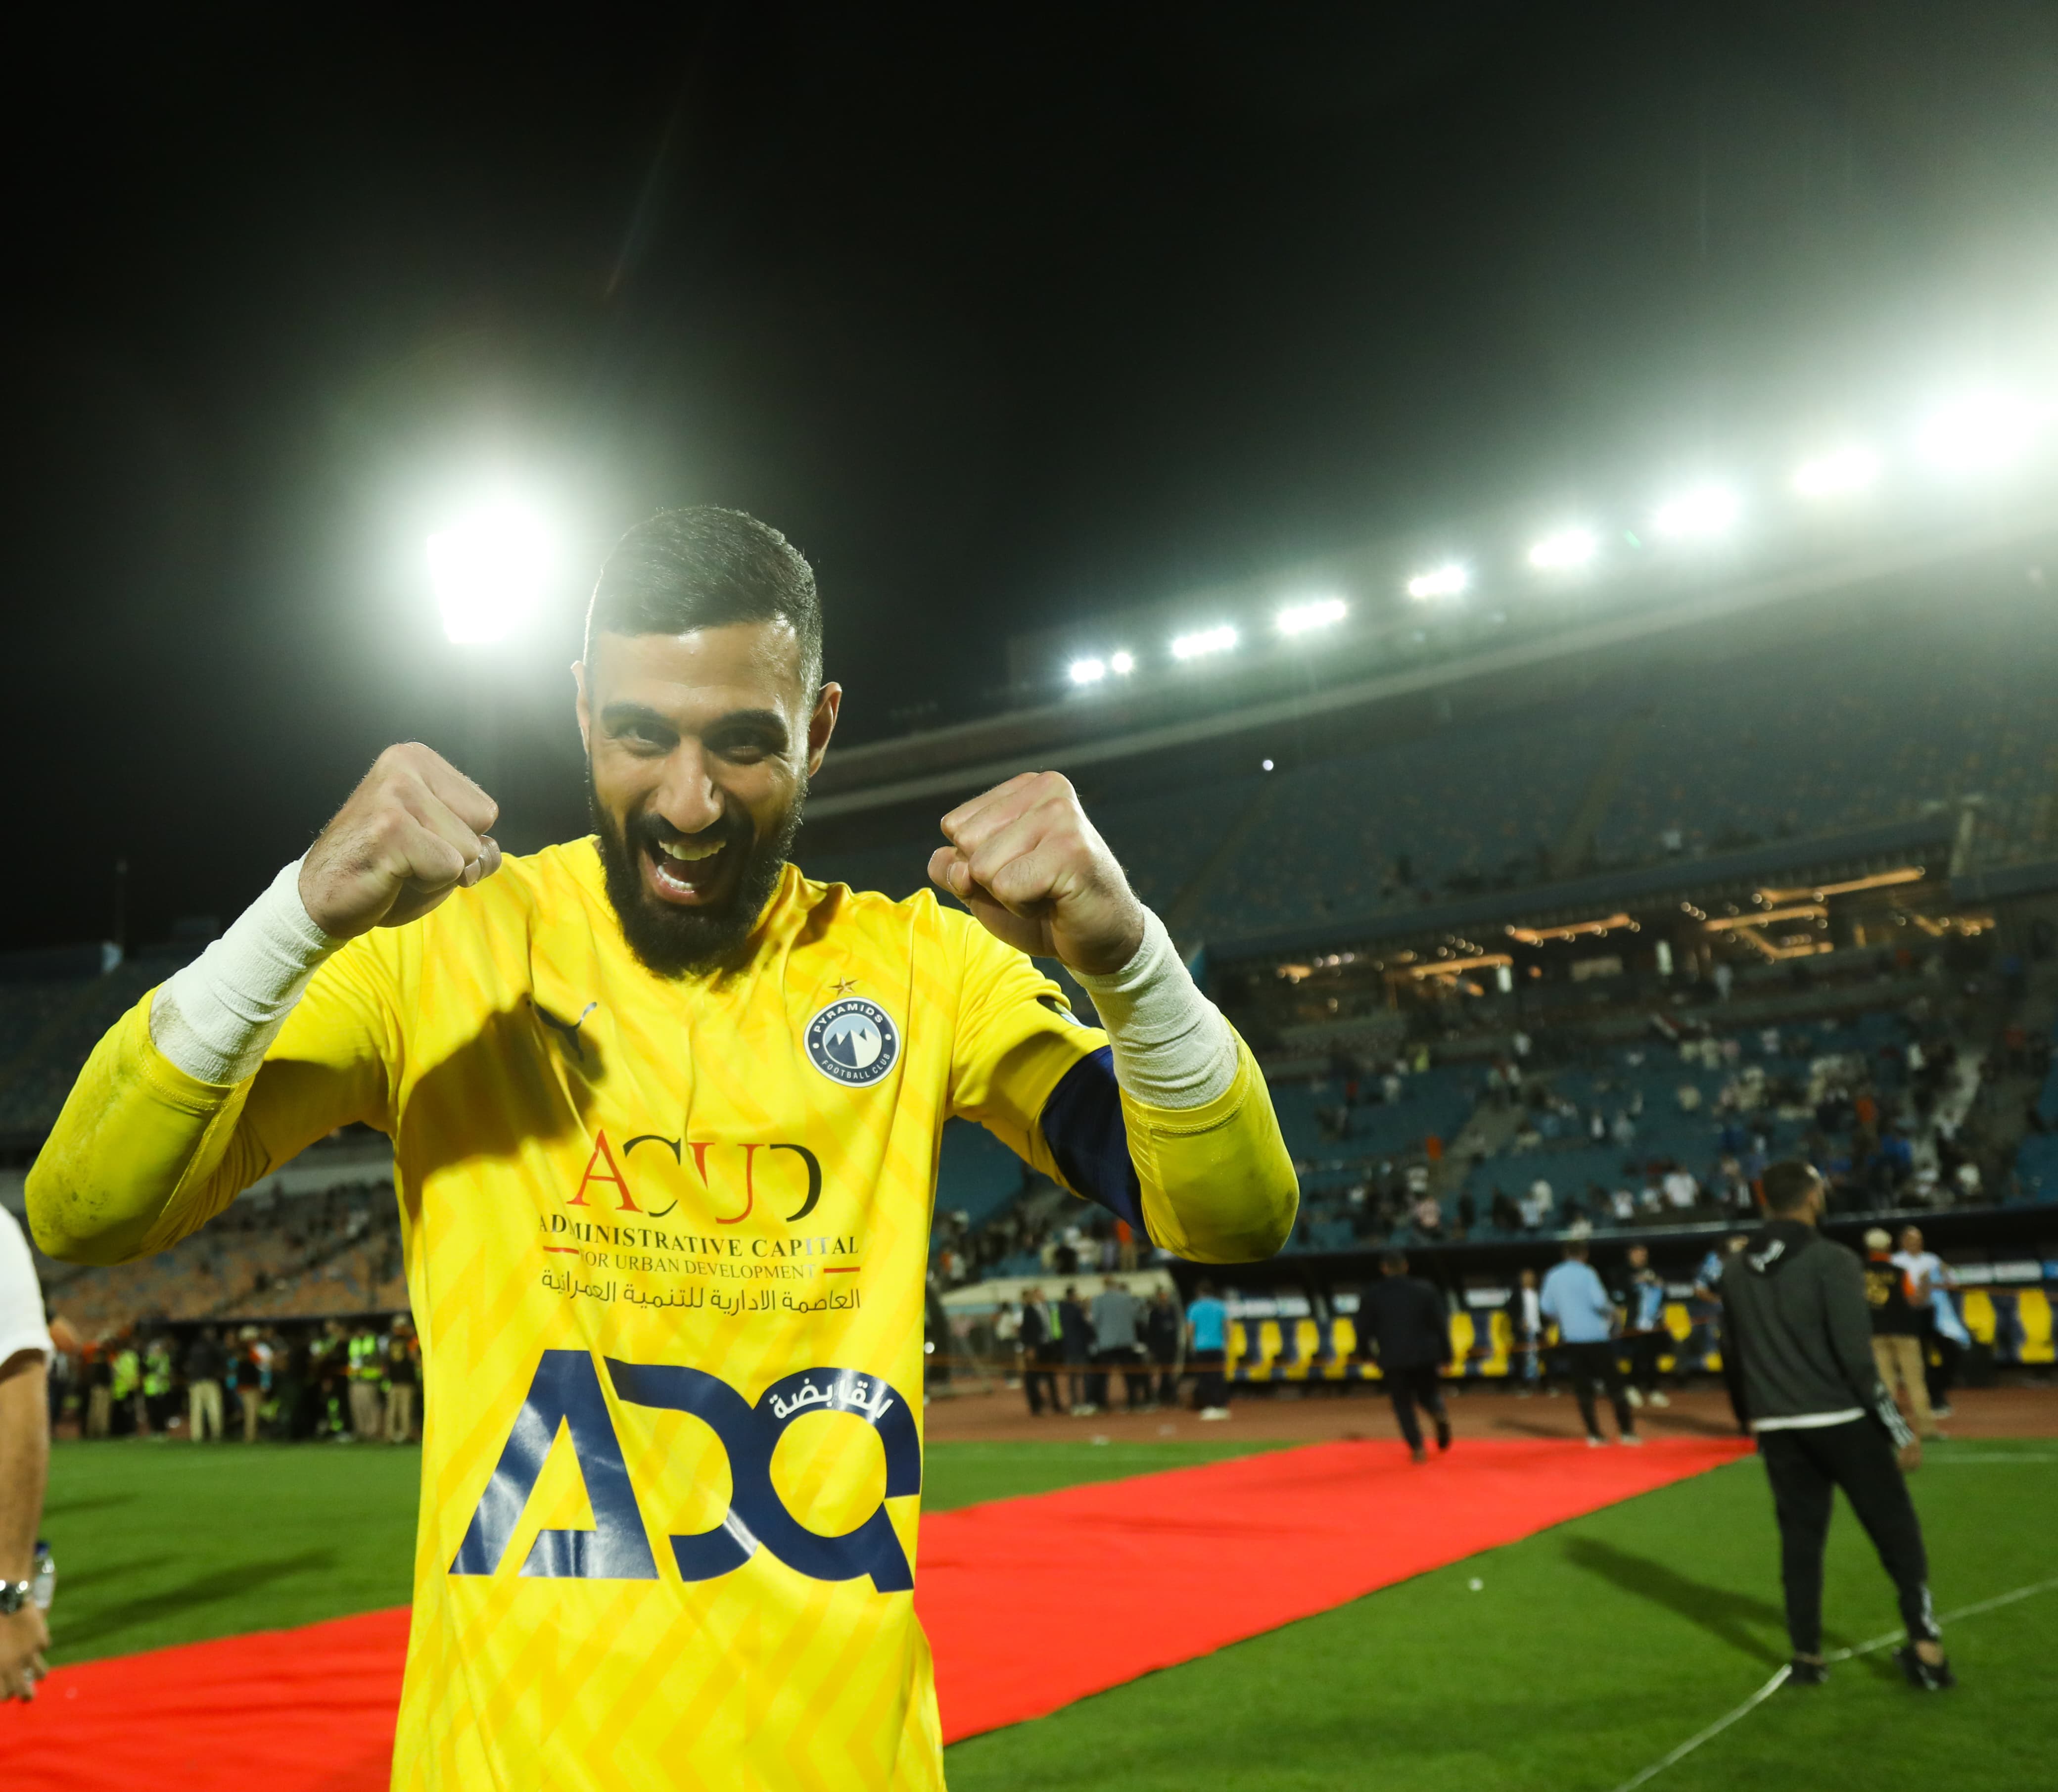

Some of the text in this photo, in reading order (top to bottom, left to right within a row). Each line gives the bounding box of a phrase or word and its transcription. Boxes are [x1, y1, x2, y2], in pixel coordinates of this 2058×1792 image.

[814, 1003, 883, 1033] PYRAMIDS
[822, 1054, 890, 1079] FOOTBALL CLUB
[566, 1129, 822, 1224] ACUD
[539, 1214, 859, 1257] ADMINISTRATIVE CAPITAL
[615, 1255, 679, 1273] URBAN
[685, 1260, 815, 1279] DEVELOPMENT
[542, 1270, 860, 1316] العاصمة الادارية للتنمية العمرانية
[769, 1378, 894, 1419] القابضة
[448, 1350, 921, 1593] ADQ
